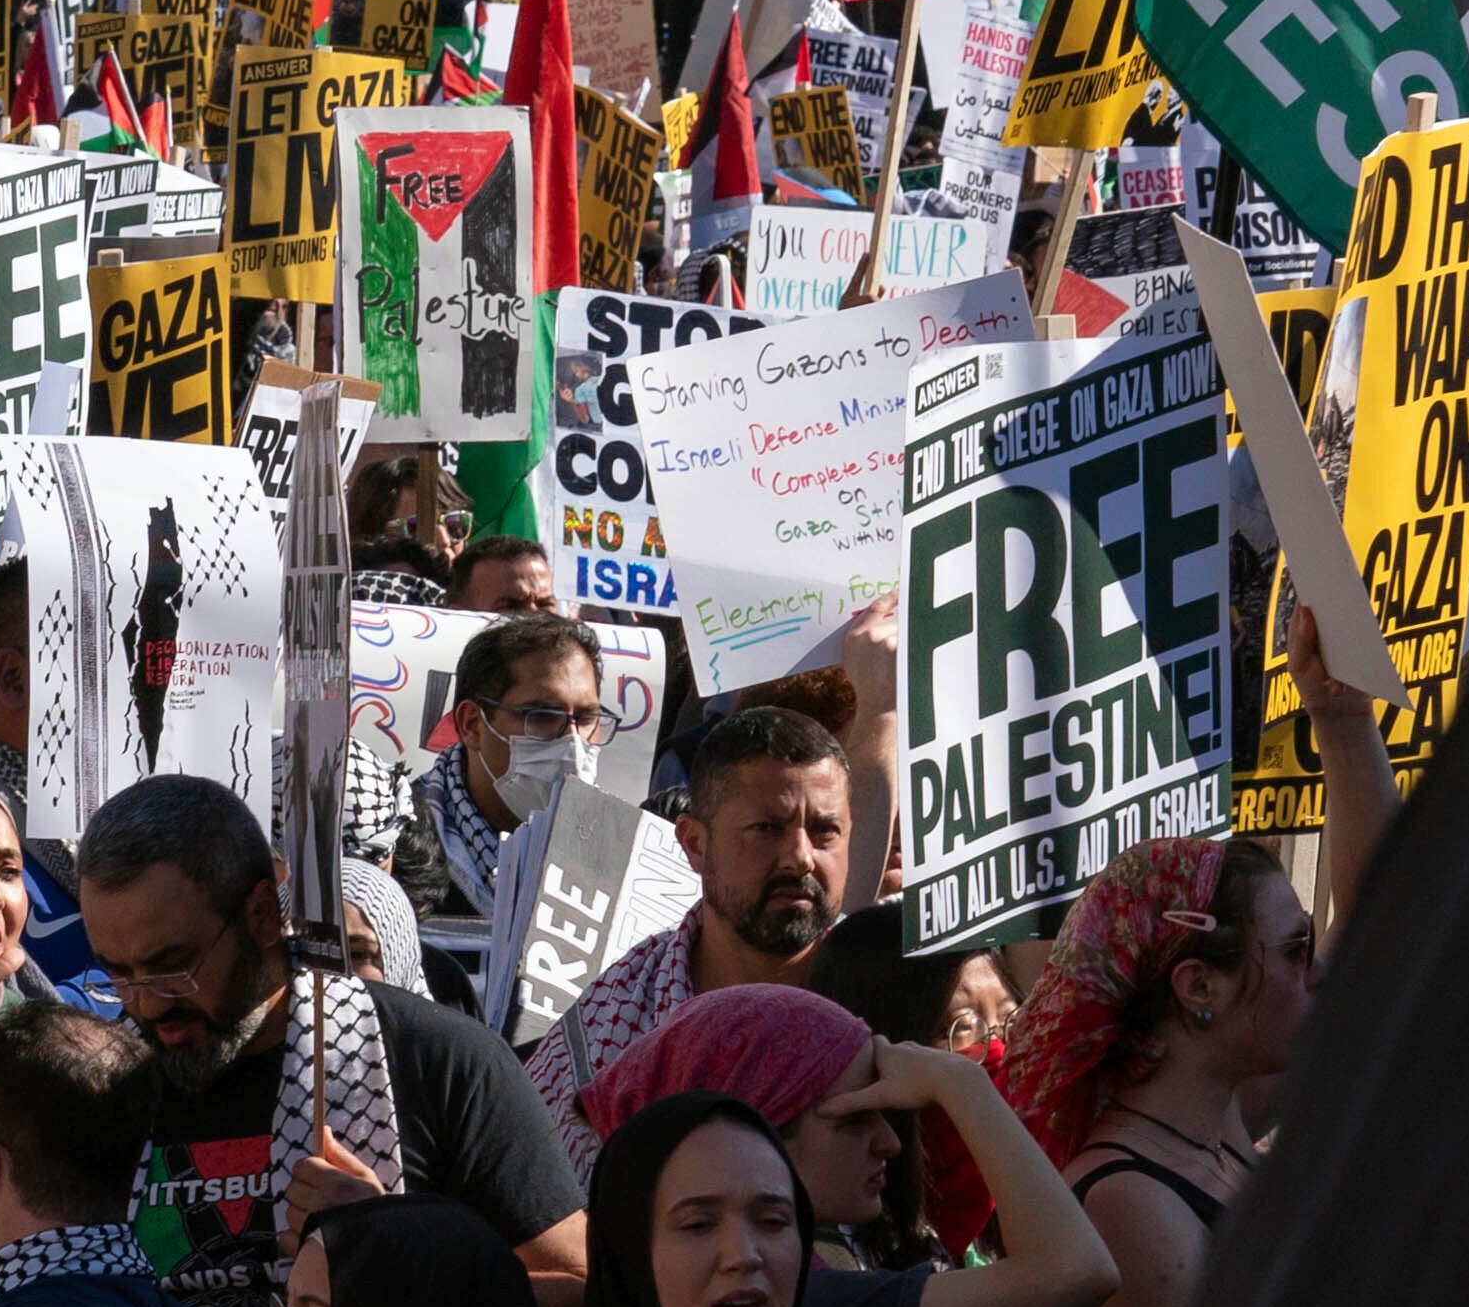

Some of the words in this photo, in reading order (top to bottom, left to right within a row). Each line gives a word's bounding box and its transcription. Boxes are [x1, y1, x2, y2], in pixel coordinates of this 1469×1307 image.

[399, 0, 431, 25] ON
[372, 25, 426, 56] GAZA
[852, 42, 888, 74] ALL
[967, 22, 1013, 53] HANDS
[242, 57, 310, 83] ANSWER
[771, 99, 808, 136] END
[812, 93, 849, 126] THE
[16, 176, 43, 213] GAZA
[46, 163, 81, 204] NOW!
[376, 143, 462, 224] FREE
[945, 181, 1013, 211] PRISONERS
[967, 172, 992, 189] OUR
[606, 210, 636, 252] ON
[231, 243, 266, 274] STOP
[272, 233, 328, 268] FUNDING
[99, 267, 223, 372] GAZA
[354, 257, 532, 346] Palestine
[643, 366, 745, 414] Starving
[757, 342, 866, 384] Gazans
[876, 329, 910, 357] to
[916, 358, 979, 417] ANSWER
[912, 442, 945, 503] END
[951, 425, 985, 484] THE
[993, 395, 1060, 467] SIEGE
[1070, 387, 1099, 444] ON
[1103, 366, 1154, 431] GAZA
[1162, 342, 1218, 411] NOW!
[651, 440, 744, 473] Israeli
[750, 421, 838, 456] Defense
[838, 489, 867, 507] on
[776, 518, 837, 543] Gaza
[857, 499, 904, 526] Stri
[907, 414, 1220, 751] FREE
[698, 587, 825, 637] Electricity
[909, 645, 1223, 869] PALESTINE!
[520, 862, 610, 1021] FREE
[143, 1172, 271, 1207] ITTSBU
